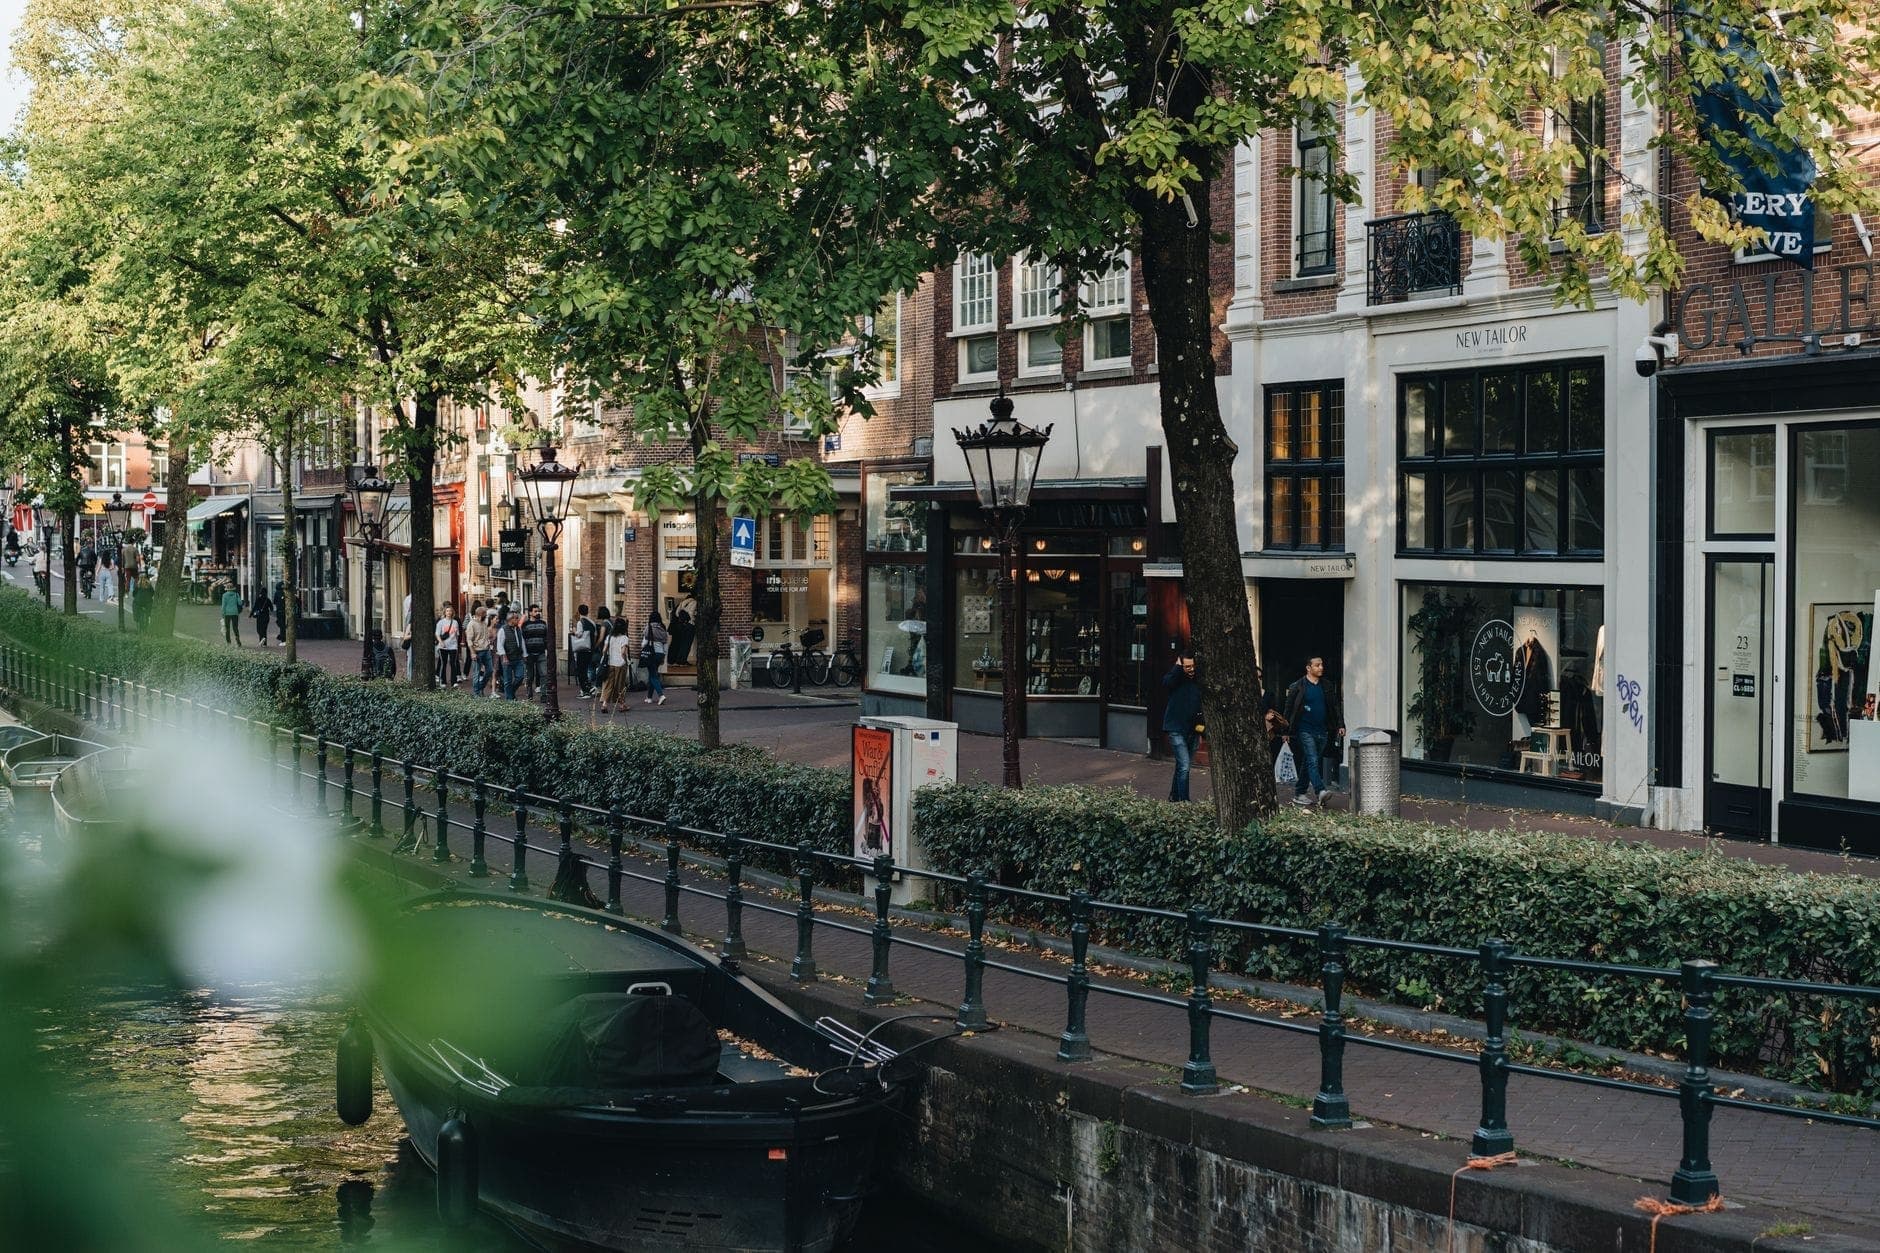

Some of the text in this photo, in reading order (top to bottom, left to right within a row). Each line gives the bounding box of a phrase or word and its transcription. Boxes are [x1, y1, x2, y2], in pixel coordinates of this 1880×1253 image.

[1456, 325, 1527, 349] NEW TAILOR
[1479, 627, 1516, 649] NEW TAILO
[1736, 635, 1748, 649] 23
[1509, 661, 1522, 698] YEARS
[1564, 750, 1600, 768] TAILOR
